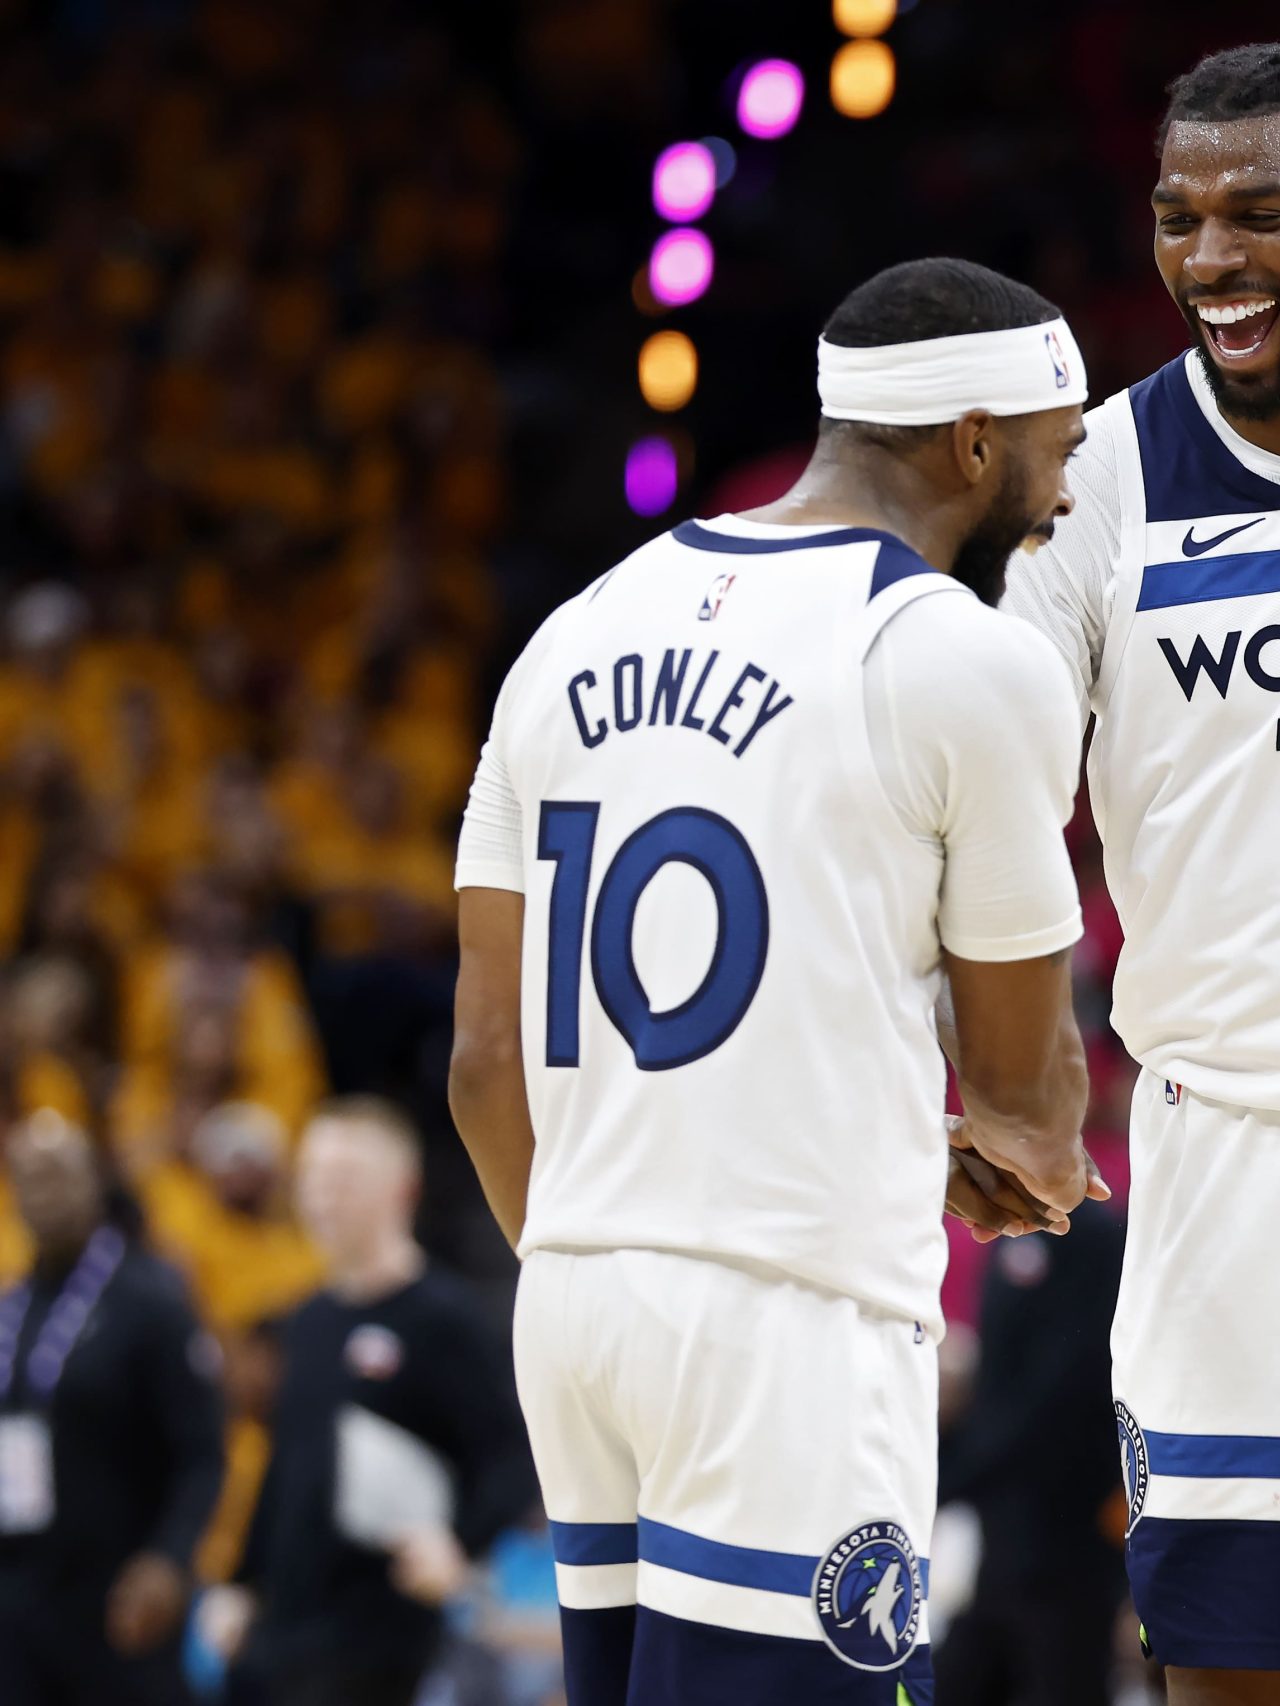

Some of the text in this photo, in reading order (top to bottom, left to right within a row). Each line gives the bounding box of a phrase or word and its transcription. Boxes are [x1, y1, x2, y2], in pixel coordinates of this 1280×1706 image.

[568, 648, 794, 758] CONLEY
[537, 800, 769, 1071] 10
[817, 1526, 880, 1614] MINNESOTA
